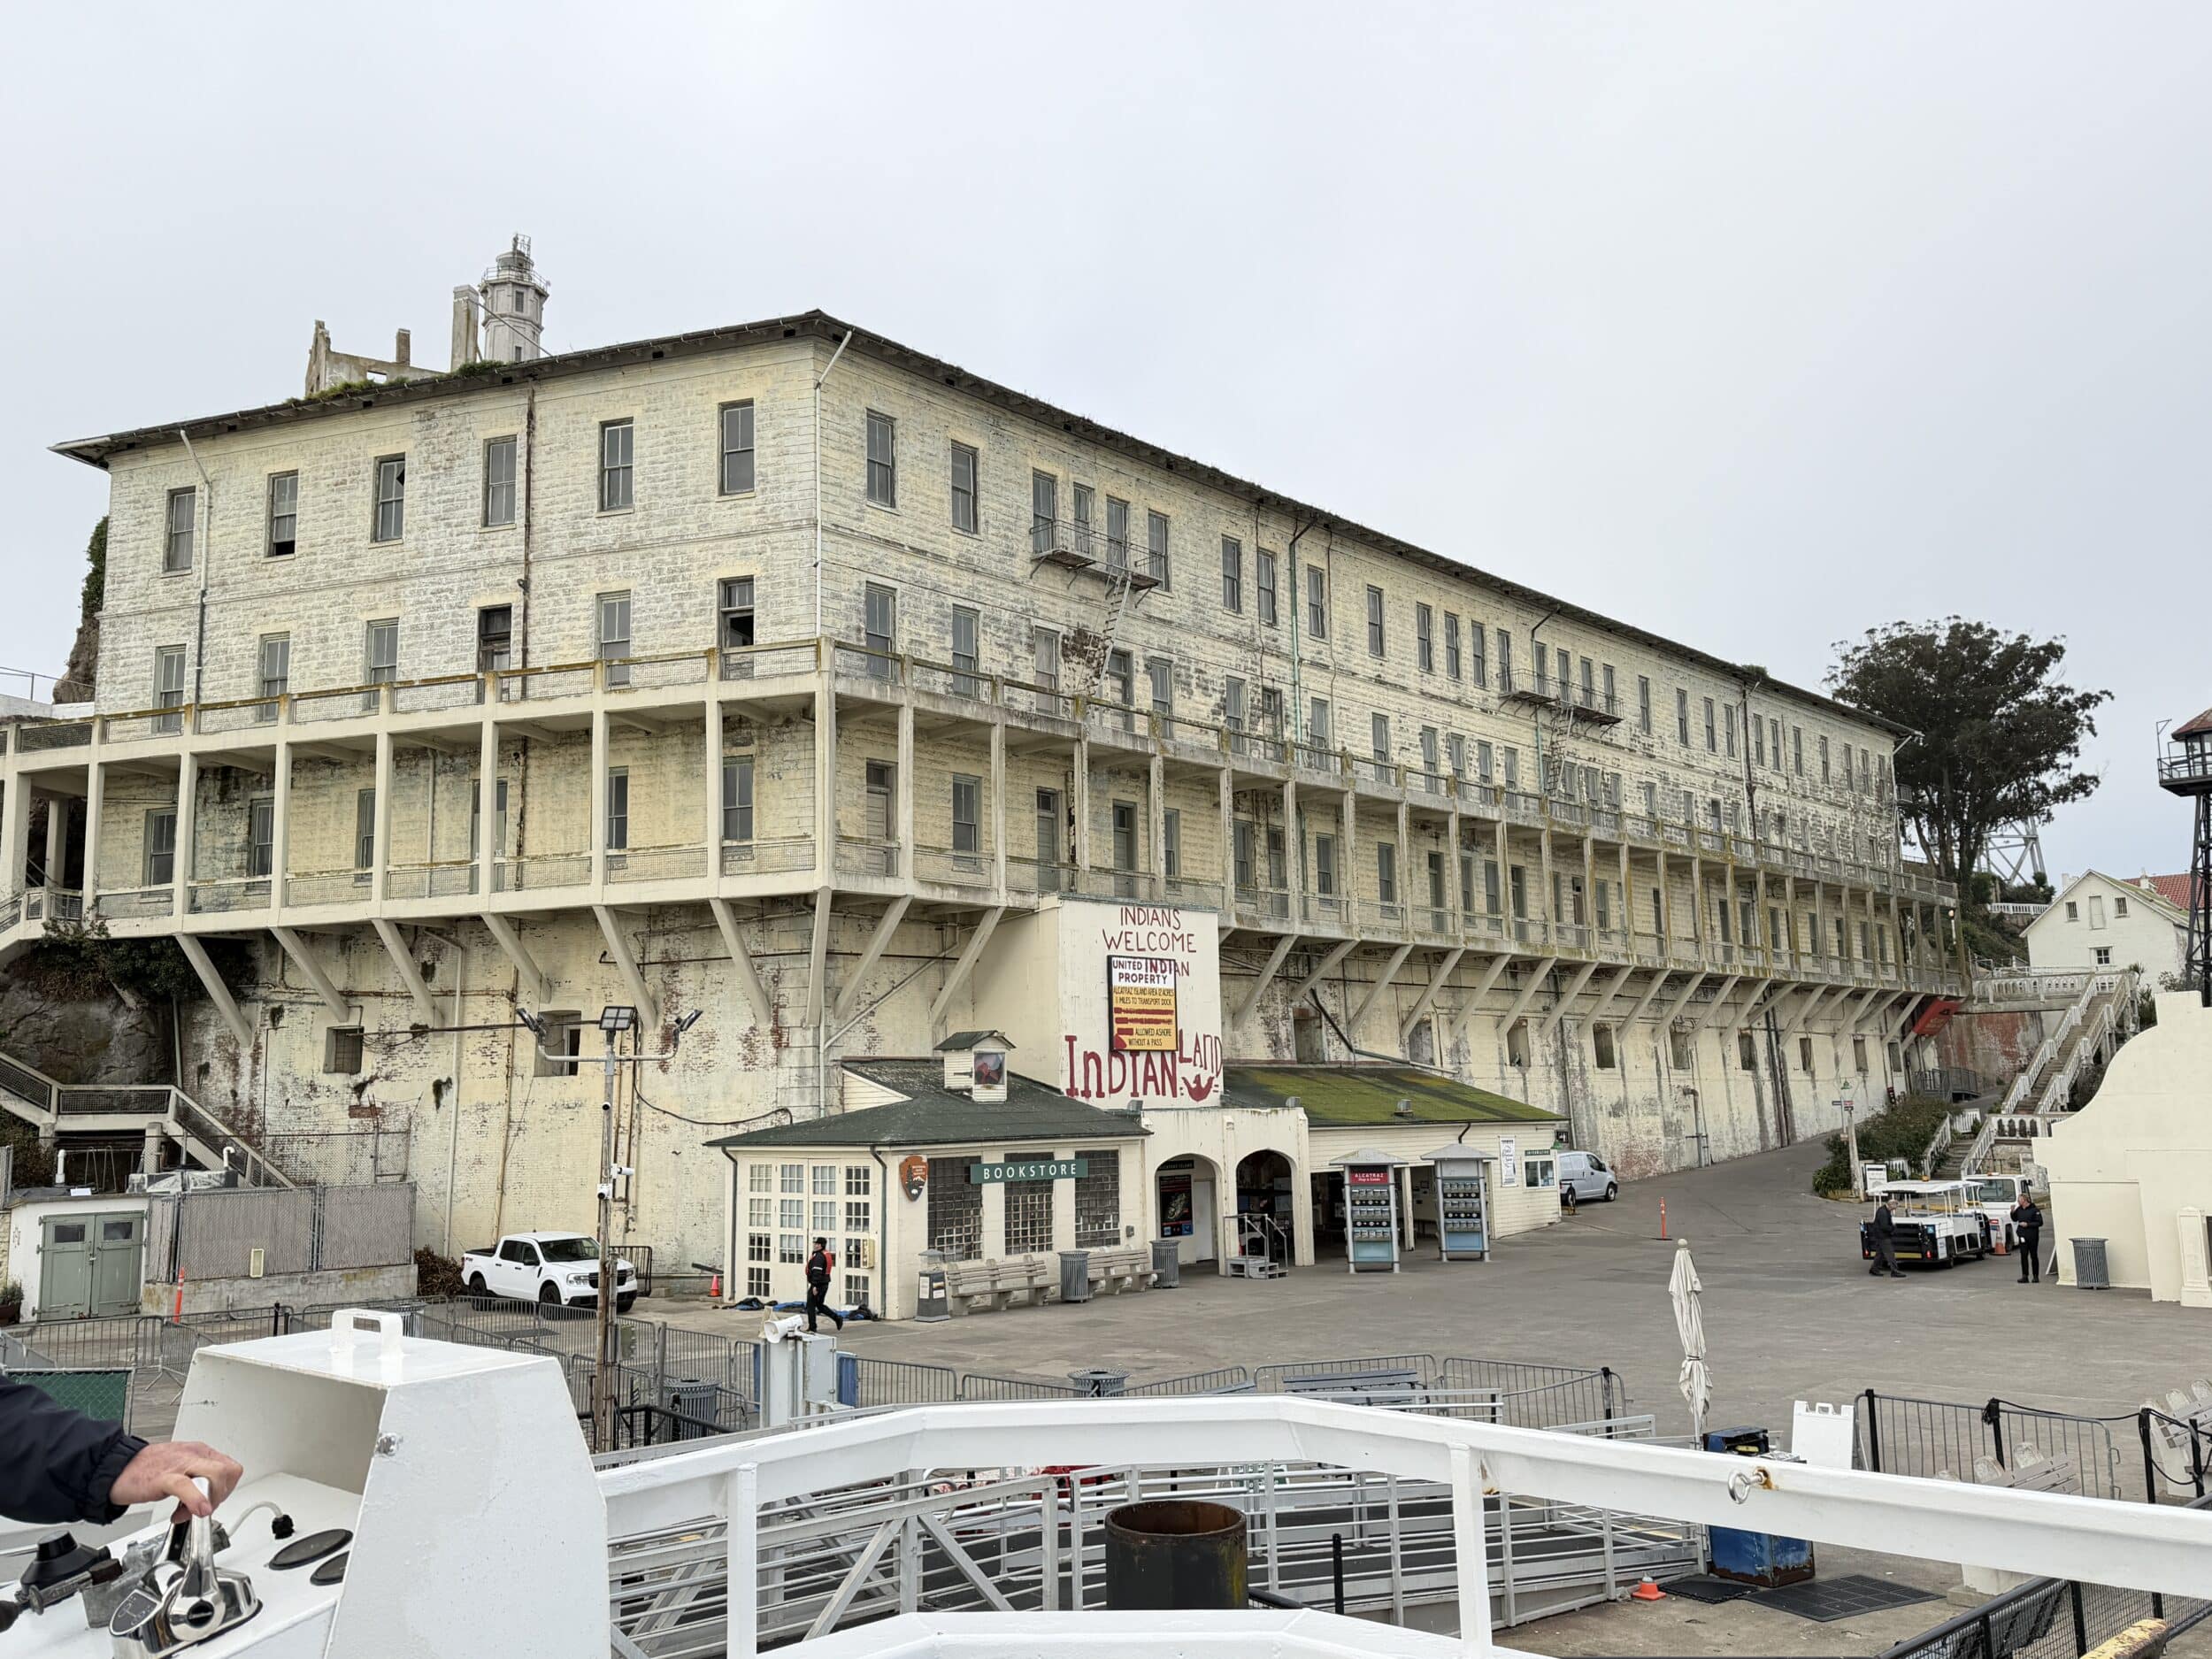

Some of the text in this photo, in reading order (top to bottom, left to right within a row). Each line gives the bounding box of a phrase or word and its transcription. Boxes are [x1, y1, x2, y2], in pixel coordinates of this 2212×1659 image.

[1120, 907, 1181, 930] INDIANS
[1102, 929, 1196, 953] WELCOME
[1112, 958, 1190, 977] UNITED INDIAN
[1118, 972, 1167, 984] PROPERTY
[983, 1164, 1077, 1179] BOOKSTORE
